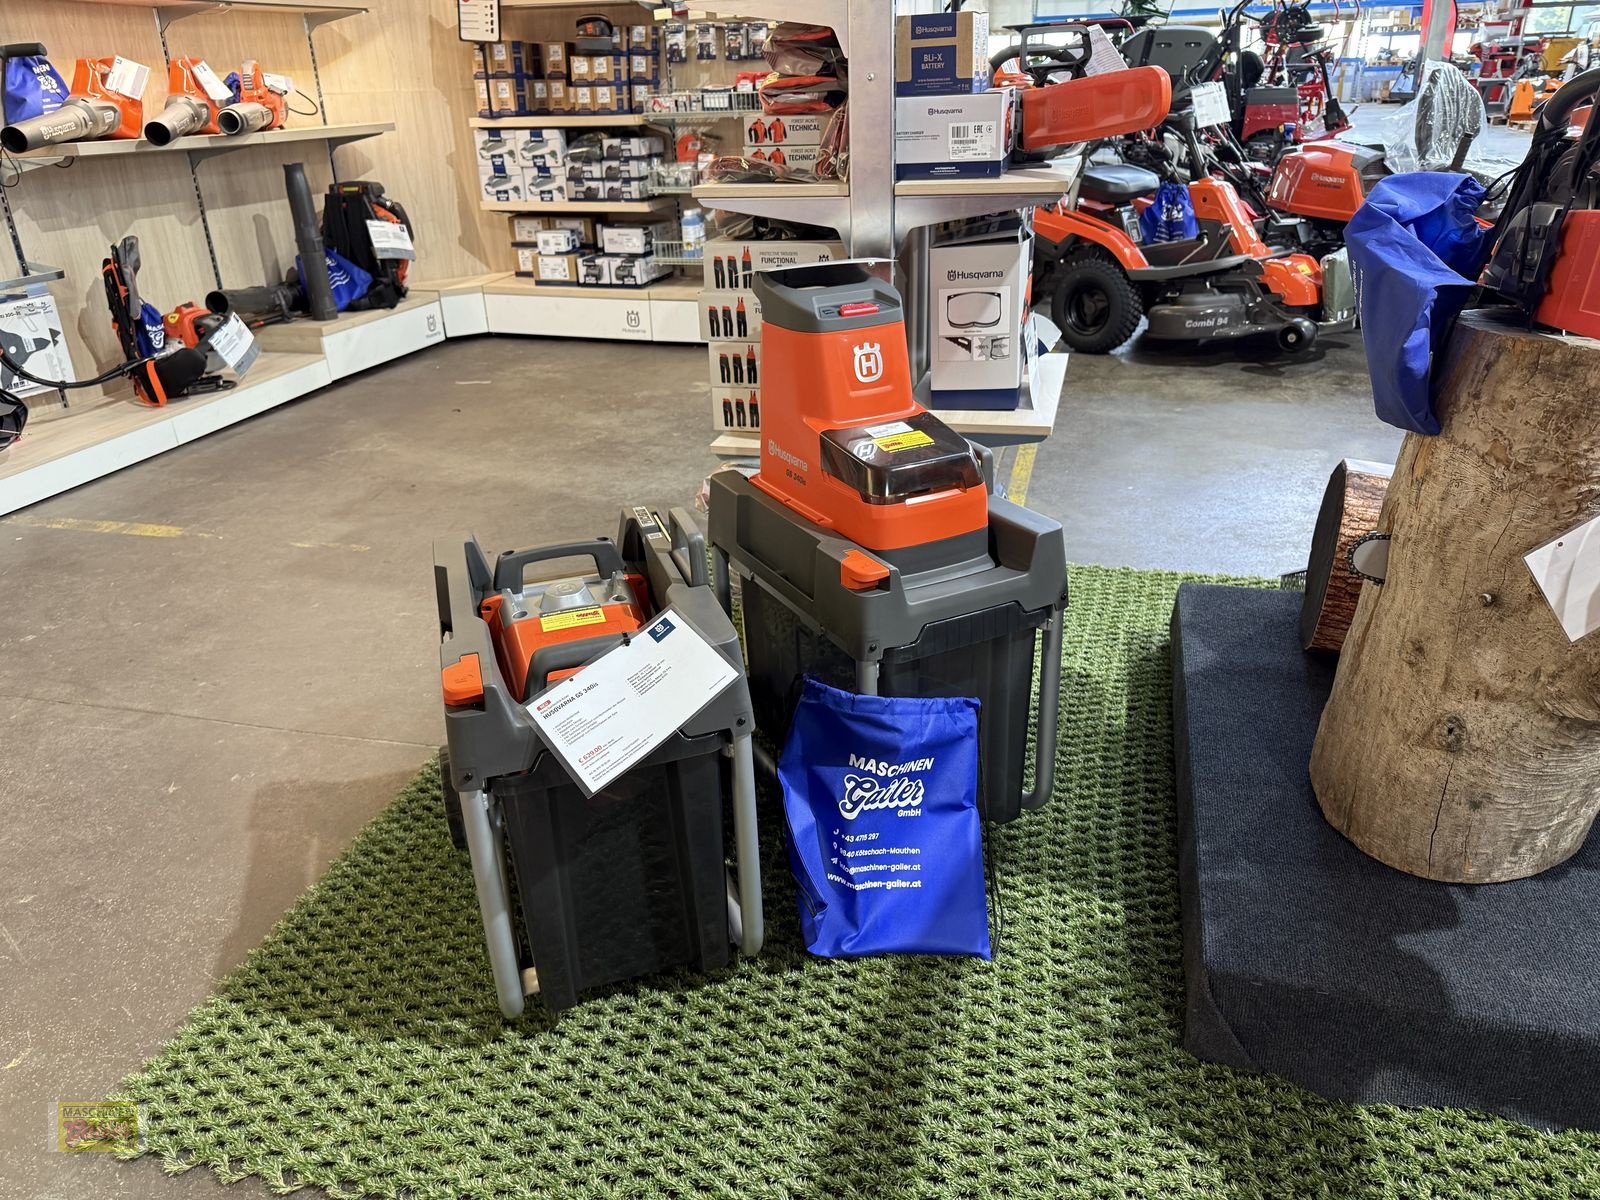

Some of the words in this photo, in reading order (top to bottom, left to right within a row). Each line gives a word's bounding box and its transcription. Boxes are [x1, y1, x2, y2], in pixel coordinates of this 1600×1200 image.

[922, 25, 952, 33] Husqvarna
[921, 62, 945, 70] BATTERY
[934, 107, 963, 116] Husqvarna
[957, 271, 1004, 279] Husqvarna
[1185, 318, 1215, 328] Combi
[775, 446, 808, 472] Husqvarna
[542, 696, 577, 720] HUSQVARNA
[849, 753, 935, 777] MASCHINEN
[897, 808, 922, 817] GmbH
